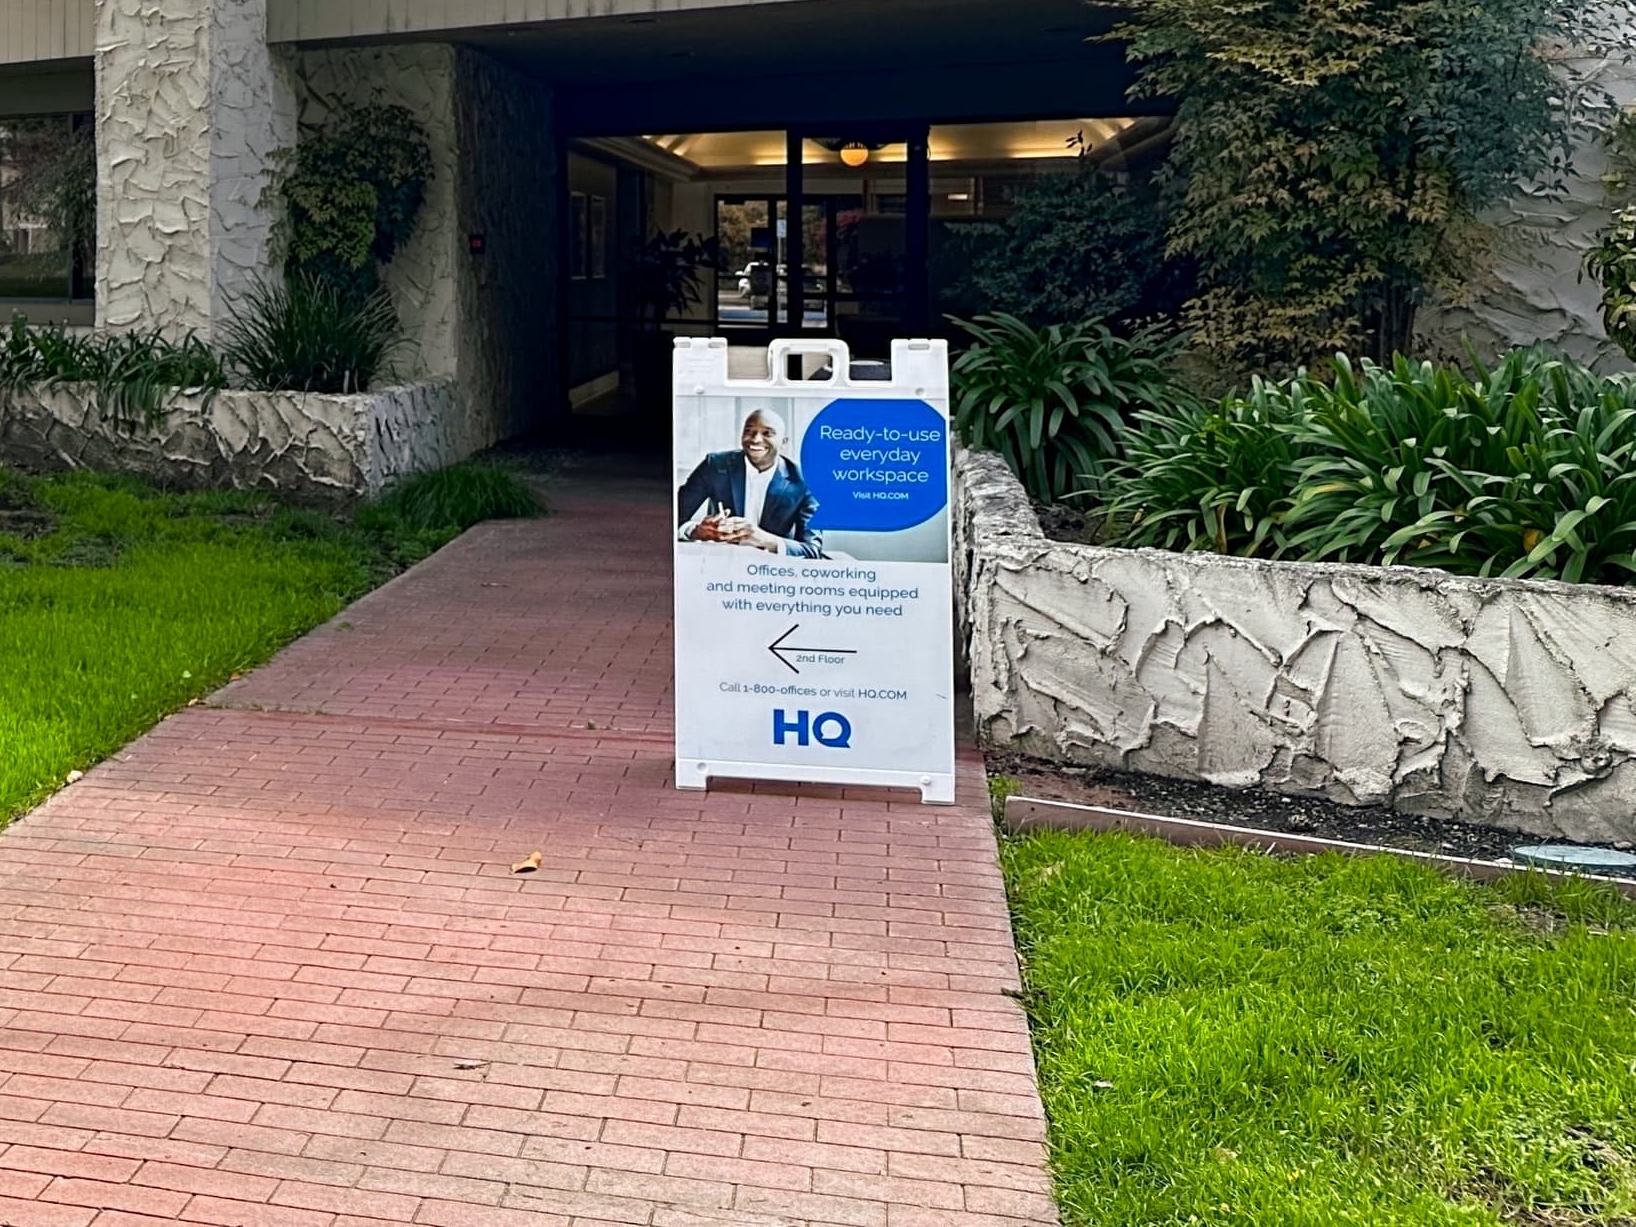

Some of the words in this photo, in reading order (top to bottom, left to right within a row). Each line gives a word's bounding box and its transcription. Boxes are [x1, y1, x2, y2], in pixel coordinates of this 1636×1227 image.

[819, 425, 941, 444] Ready-to-use
[839, 447, 921, 465] everyday
[832, 468, 929, 485] workspace
[852, 491, 871, 500] Visit
[873, 491, 909, 500] HQ.COM
[747, 564, 798, 578] Offices,
[801, 566, 876, 583] coworking
[706, 581, 733, 592] and
[737, 582, 796, 597] meeting
[799, 585, 845, 597] rooms
[848, 587, 919, 600] equipped
[722, 599, 752, 611] with
[756, 601, 831, 616] everything
[835, 604, 862, 617] you
[866, 605, 903, 616] need
[795, 654, 815, 663] 2nd
[818, 654, 845, 664] Floor
[719, 682, 741, 693] Call
[743, 683, 817, 697] 1-800-offices
[819, 688, 832, 697] or
[834, 687, 856, 699] visit
[858, 689, 907, 701] HQ.COM
[773, 708, 852, 748] HQ
